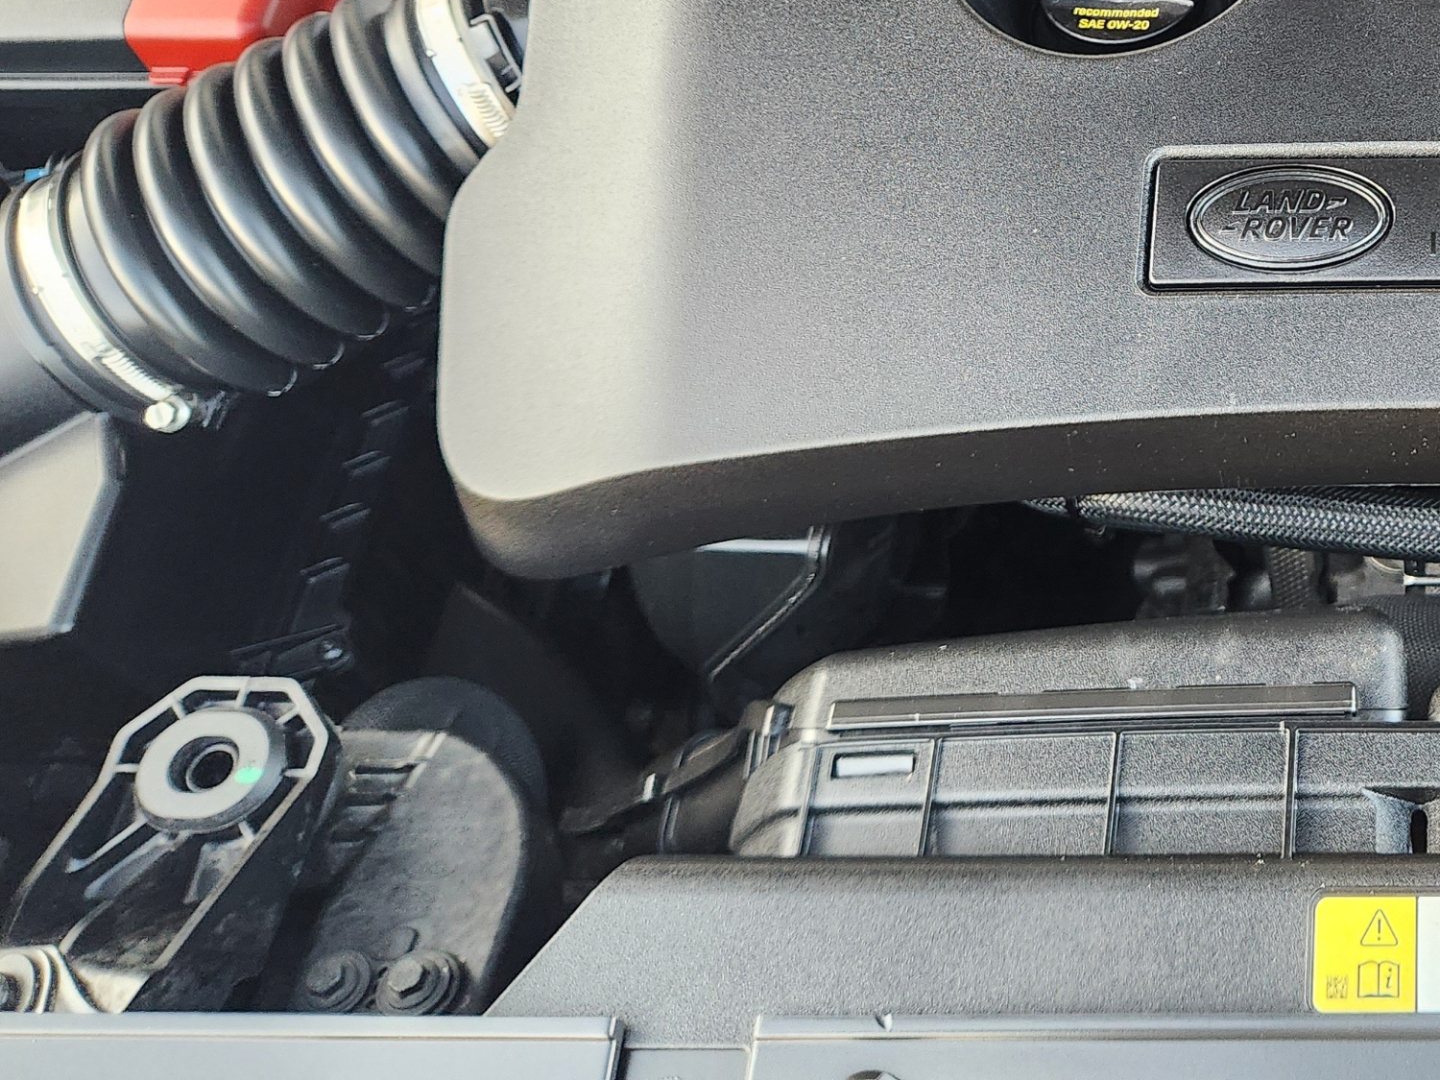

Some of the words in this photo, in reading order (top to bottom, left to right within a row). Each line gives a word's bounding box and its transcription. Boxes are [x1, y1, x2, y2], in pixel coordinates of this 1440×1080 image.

[1073, 7, 1159, 18] recommended
[1078, 19, 1105, 30] SAE
[1107, 19, 1150, 31] 0W-20
